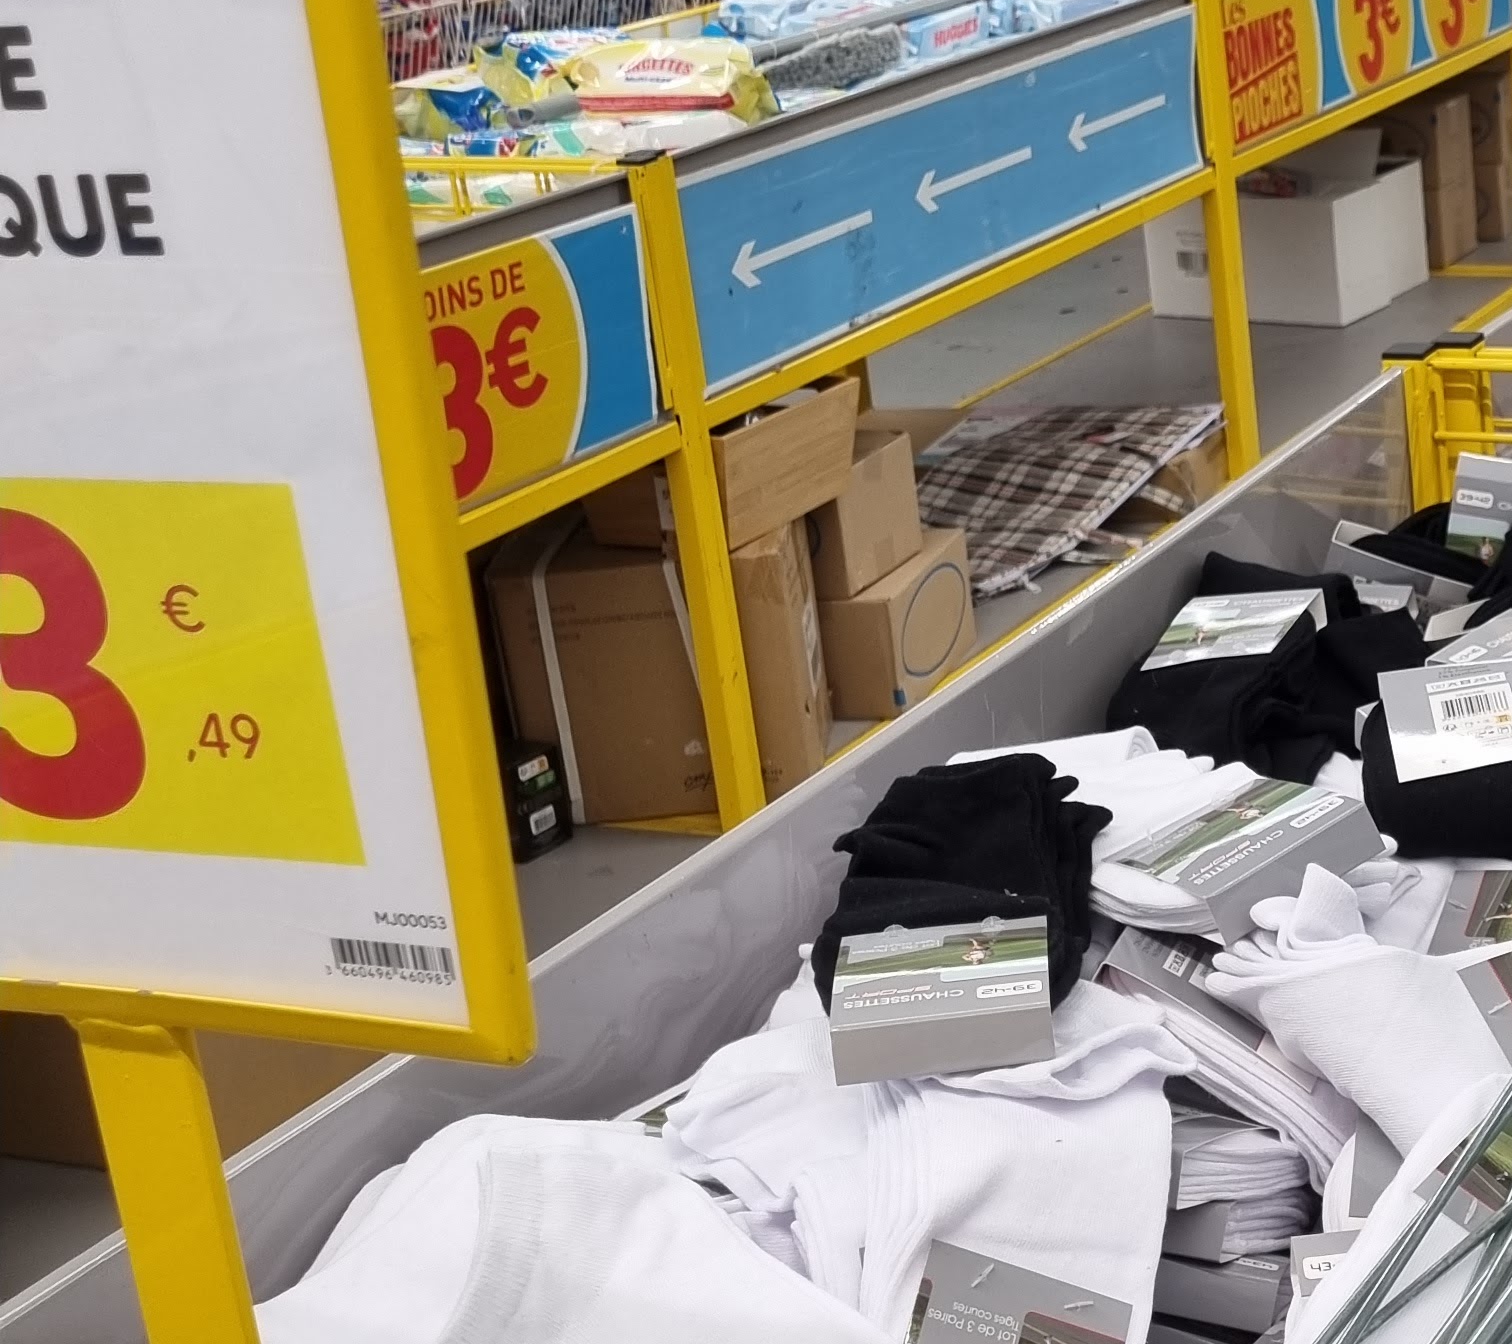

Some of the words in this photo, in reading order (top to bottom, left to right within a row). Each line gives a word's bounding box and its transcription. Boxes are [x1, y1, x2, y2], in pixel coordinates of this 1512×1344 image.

[1224, 7, 1296, 91] BONNES
[0, 25, 48, 110] E
[1231, 58, 1303, 144] PIOCHES
[423, 275, 484, 322] OINS
[490, 261, 526, 301] DE
[430, 306, 550, 501] 3€
[0, 506, 147, 821] 3
[160, 584, 206, 633] €
[1192, 829, 1285, 886] CHAUSSETTES
[843, 988, 965, 1009] CHAUSSETTES
[844, 984, 934, 1000] SPORT
[980, 982, 1038, 995] 39-42
[927, 1307, 965, 1331] Paires
[952, 1300, 992, 1321] courtes
[967, 1320, 976, 1333] 3
[977, 1325, 995, 1338] de
[993, 1314, 1020, 1332] Tiges
